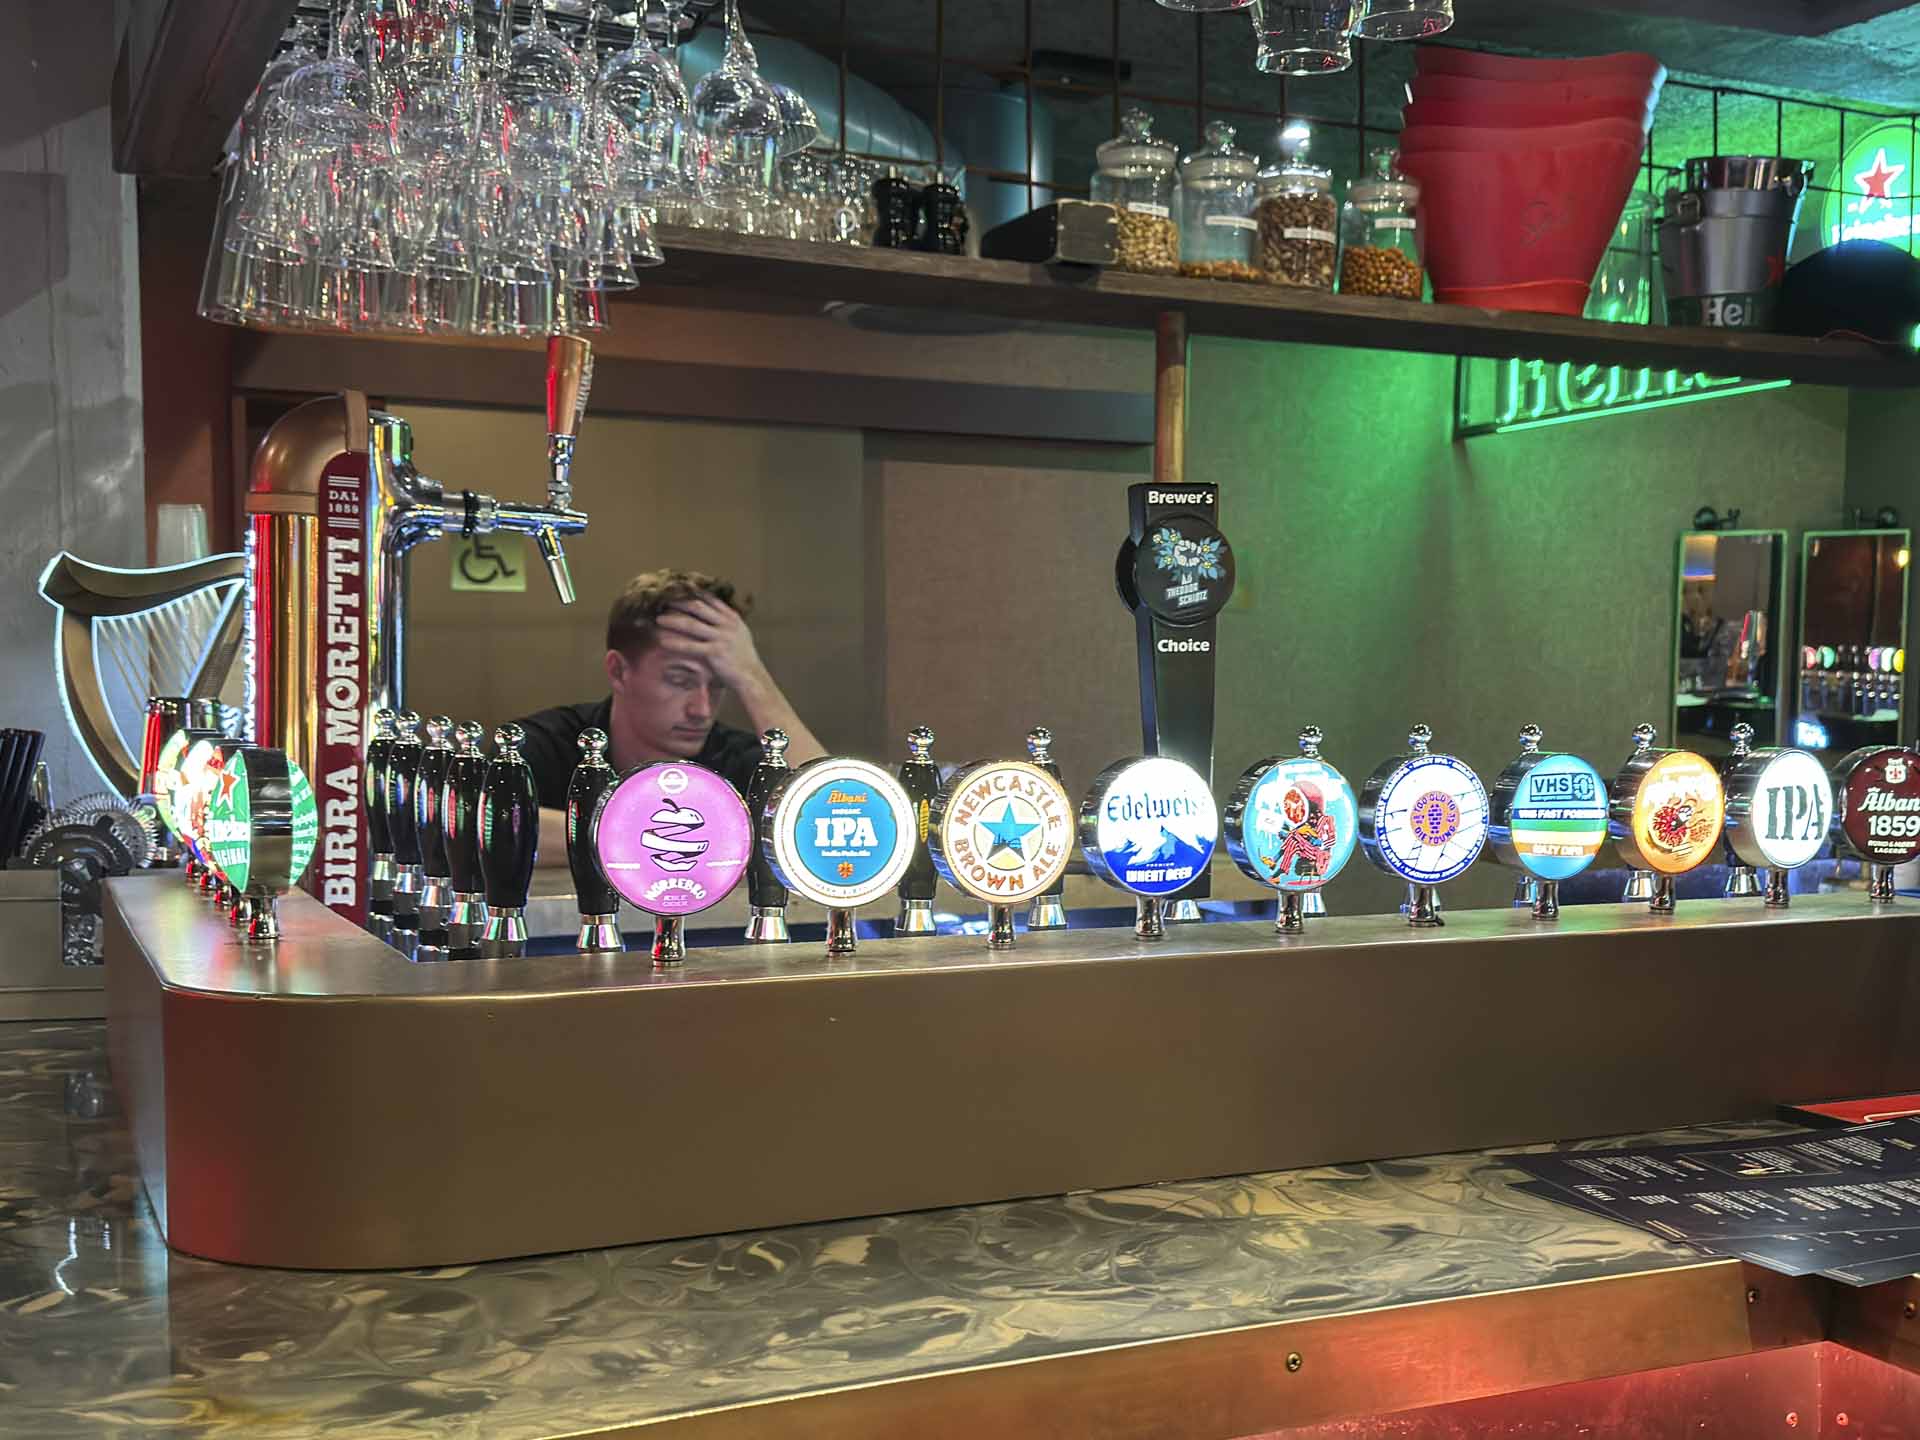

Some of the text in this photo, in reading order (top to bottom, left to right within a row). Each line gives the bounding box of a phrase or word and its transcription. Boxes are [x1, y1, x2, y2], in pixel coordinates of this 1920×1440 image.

[328, 490, 359, 501] DAL
[1148, 491, 1214, 504] Brewer's
[328, 503, 359, 514] 1859
[1157, 638, 1210, 652] Choice
[324, 537, 360, 907] BIRRA MORETTI
[1534, 777, 1570, 793] VHS
[954, 775, 1062, 831] NEWCASTLE
[1764, 783, 1825, 841] IPA
[814, 817, 879, 847] IPA
[1868, 815, 1920, 837] 1859
[954, 839, 1062, 891] BROWN ALE
[1126, 868, 1165, 882] WHEAT
